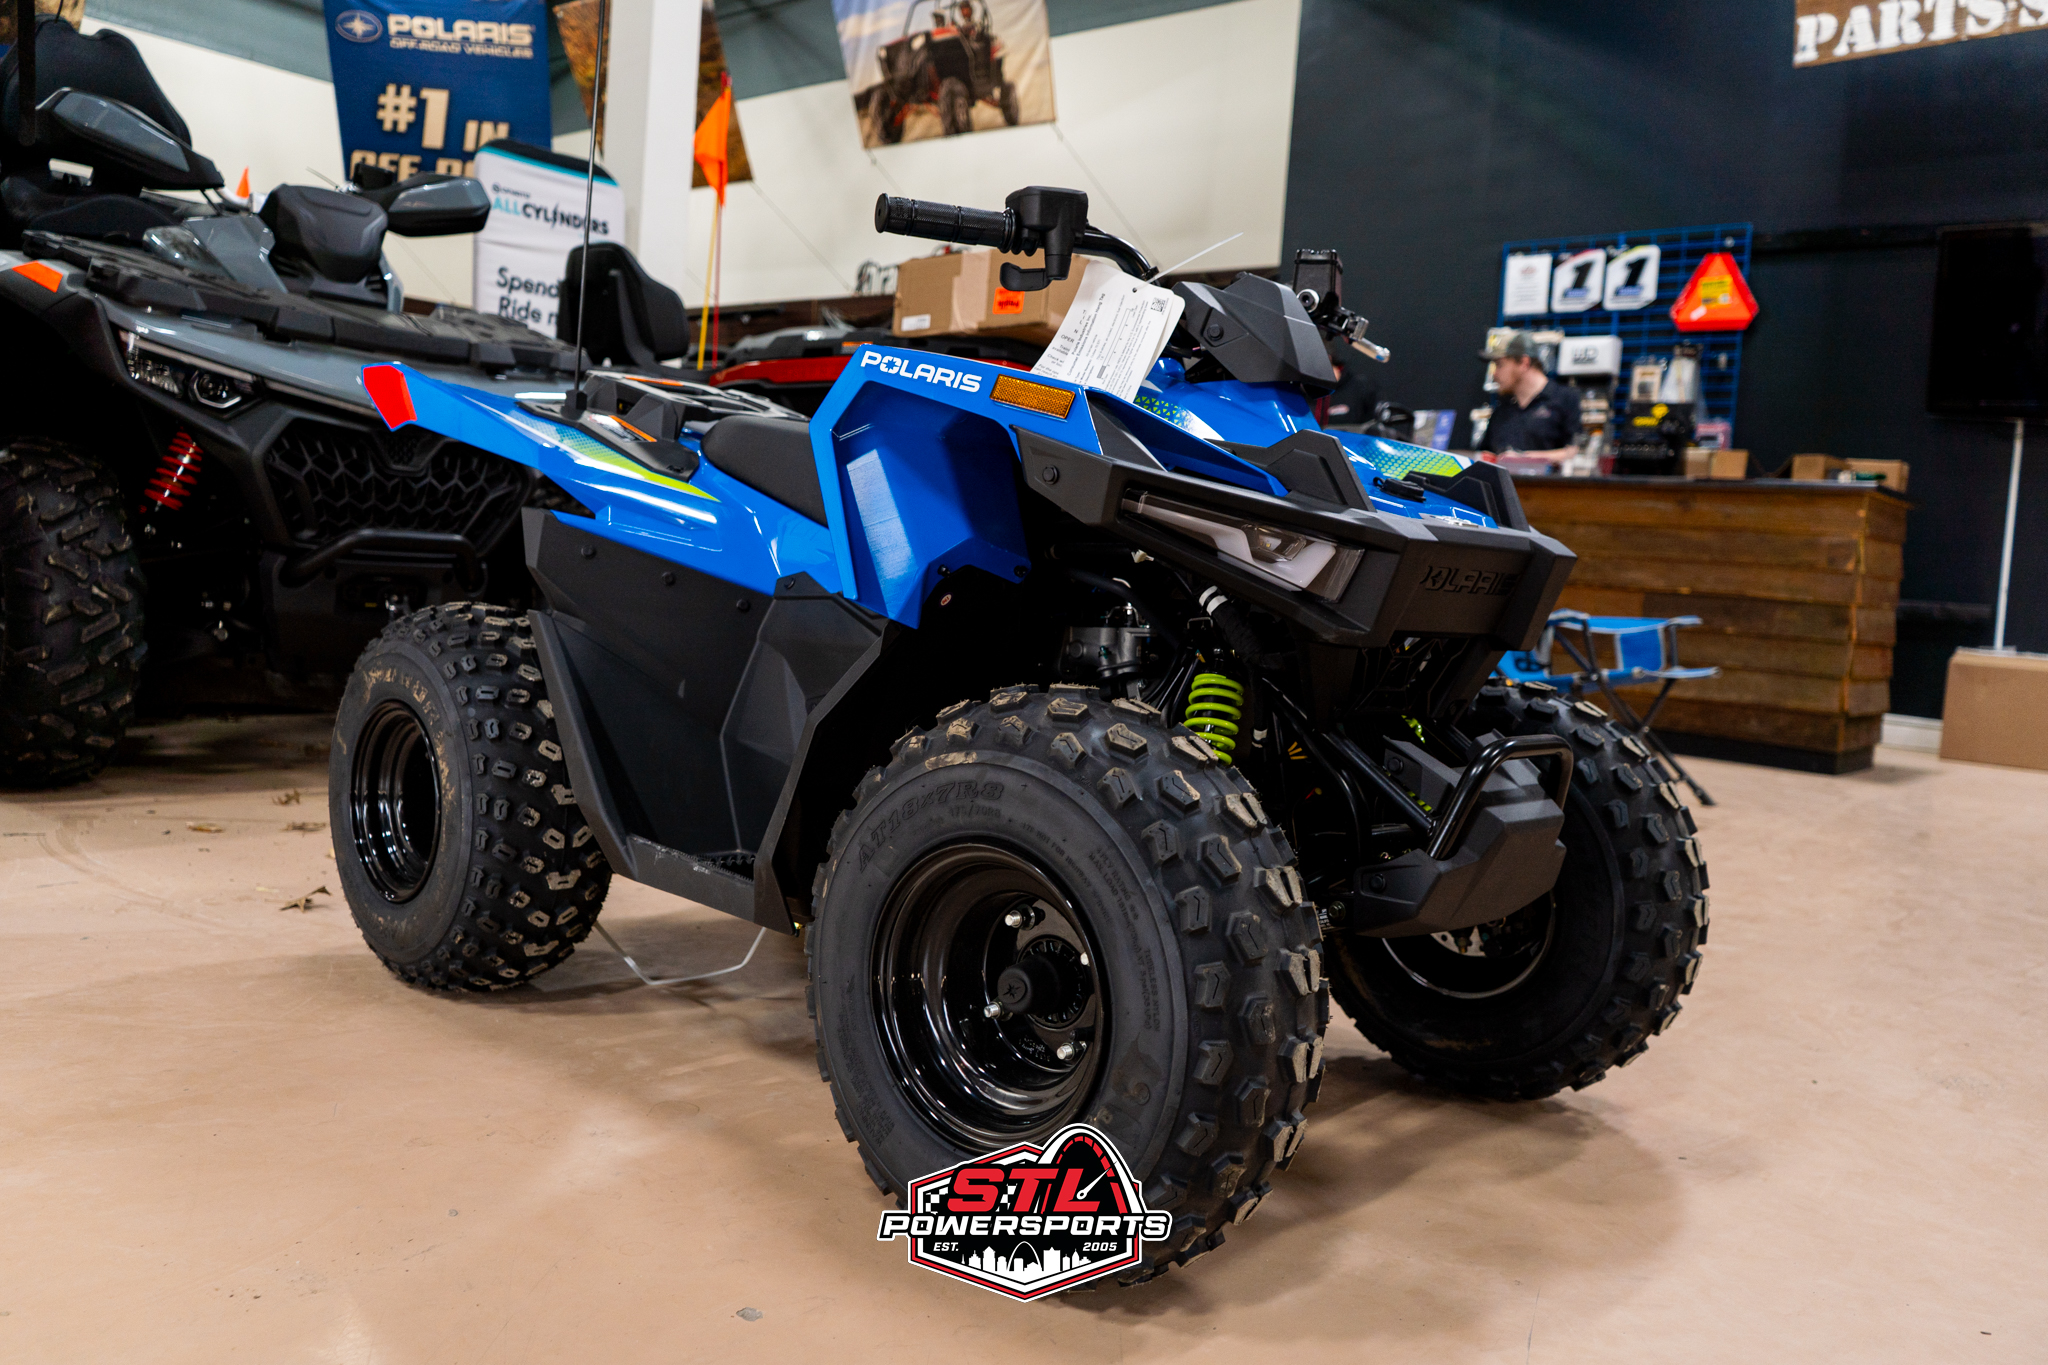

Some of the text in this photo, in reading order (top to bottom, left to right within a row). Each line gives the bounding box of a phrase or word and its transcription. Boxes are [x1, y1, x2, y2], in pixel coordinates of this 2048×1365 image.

[387, 13, 534, 46] POLARIS
[1793, 0, 2004, 63] PARTS
[390, 38, 534, 60] OFF-ROAD VEHICLES
[375, 82, 450, 151] #1
[1573, 260, 1595, 289] 1
[1624, 256, 1648, 287] 1
[499, 296, 542, 323] Ride
[1075, 335, 1088, 357] Emissions
[1085, 312, 1098, 336] Information
[860, 350, 983, 393] POLARIS
[1099, 871, 1122, 897] LOAD
